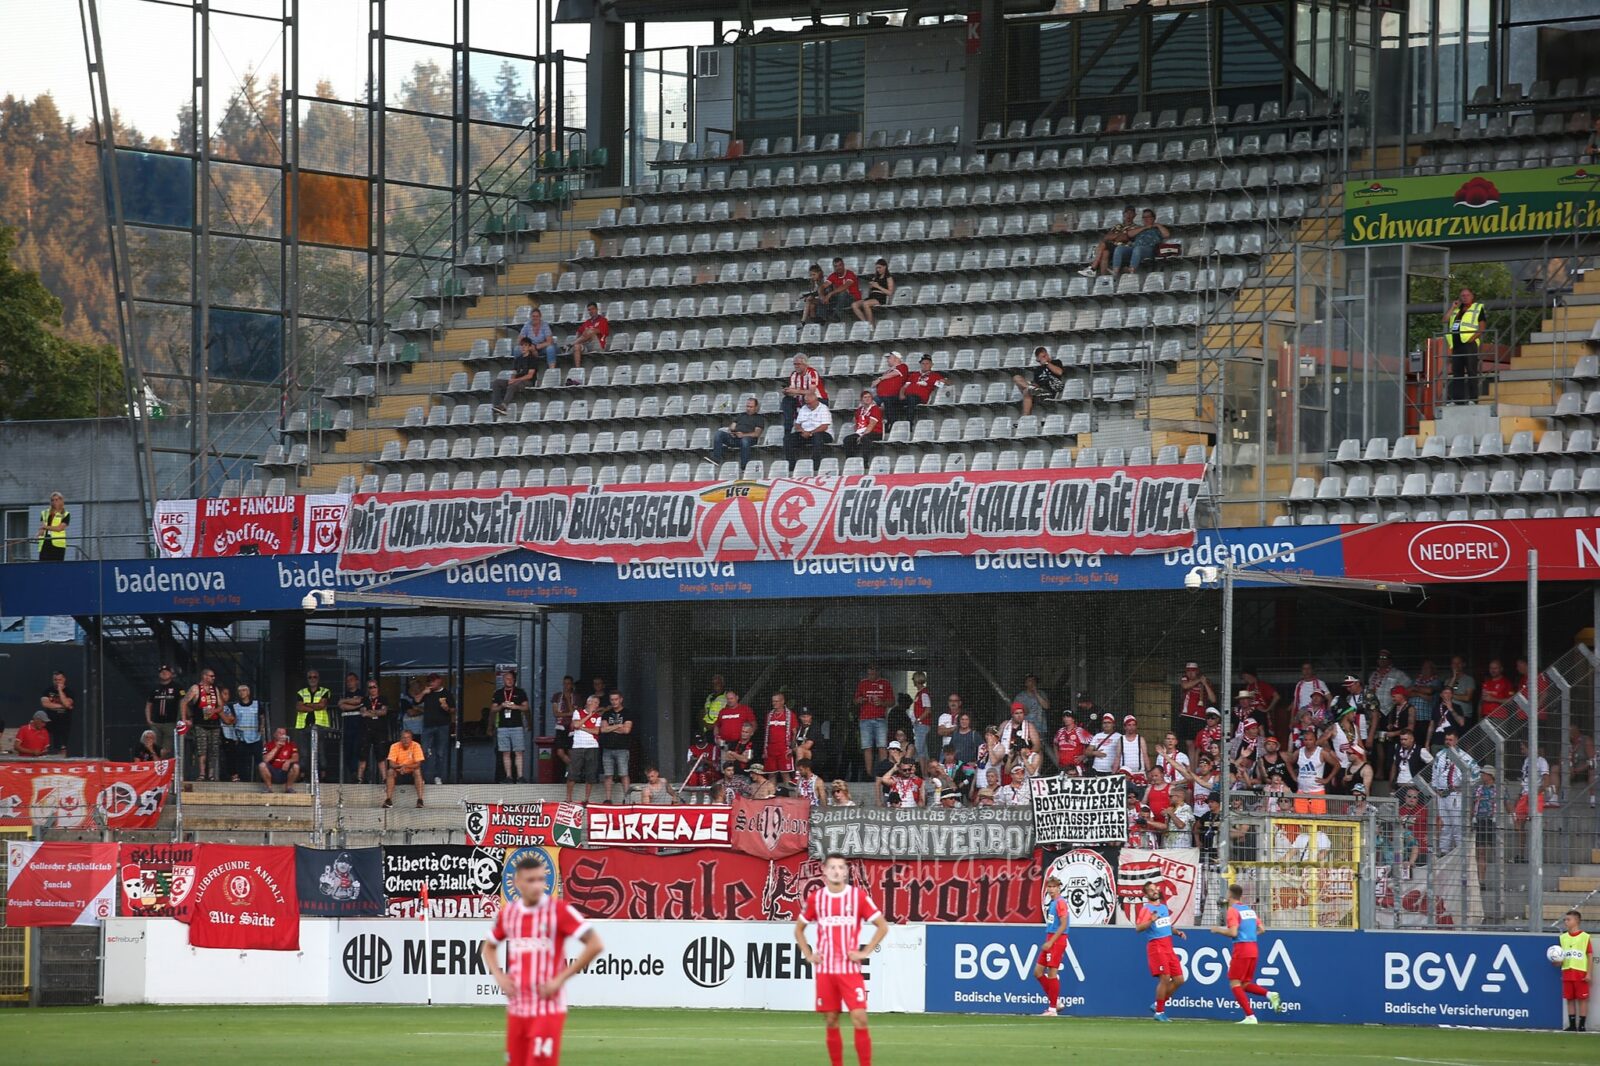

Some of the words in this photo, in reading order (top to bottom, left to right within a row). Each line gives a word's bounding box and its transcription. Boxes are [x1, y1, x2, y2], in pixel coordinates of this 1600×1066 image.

[968, 22, 980, 39] K
[1351, 200, 1600, 241] Schwarzwaldmilch
[726, 487, 749, 498] HFC
[206, 499, 230, 517] HFC
[240, 496, 295, 515] FANCLUB
[313, 508, 342, 520] HFC
[523, 494, 566, 542] UND
[571, 484, 695, 541] BÜRGERGELD
[838, 480, 879, 538] FÜR
[974, 480, 1045, 534] HALLE
[1049, 480, 1089, 532] UM
[1137, 481, 1200, 533] WELT
[160, 513, 183, 524] HFC
[213, 522, 281, 553] Edelfans
[115, 565, 225, 593] badenova
[446, 560, 561, 584] badenova
[1033, 776, 1125, 796] TELEKOM
[503, 803, 543, 813] SEKTION
[1035, 794, 1125, 811] BOYKOTTIEREN
[491, 814, 551, 827] MANSFELD
[590, 813, 730, 841] SURREALE
[1036, 811, 1125, 828] MONTAGSSPIELE
[494, 830, 545, 846] SÜDHARZ
[387, 853, 437, 872] Libertà
[1157, 858, 1187, 880] HFC
[195, 860, 250, 903] CLUBFREUNDE
[254, 865, 285, 904] ANHALT
[439, 874, 474, 891] Halle
[564, 856, 756, 921] Saale
[209, 911, 236, 925] Alte
[239, 910, 276, 927] Säcke
[390, 898, 483, 919] STNDAL
[343, 933, 393, 984] AHP
[682, 936, 735, 988] AHP
[955, 943, 1038, 981] BGV
[1384, 952, 1477, 992] BGV
[954, 991, 1001, 1003] Badische
[1004, 992, 1085, 1007] Versichengen
[1215, 997, 1301, 1013] Versherugen
[1385, 1001, 1437, 1015] Badische
[1439, 1003, 1530, 1019] Versicherungen
[534, 1037, 554, 1057] 14
